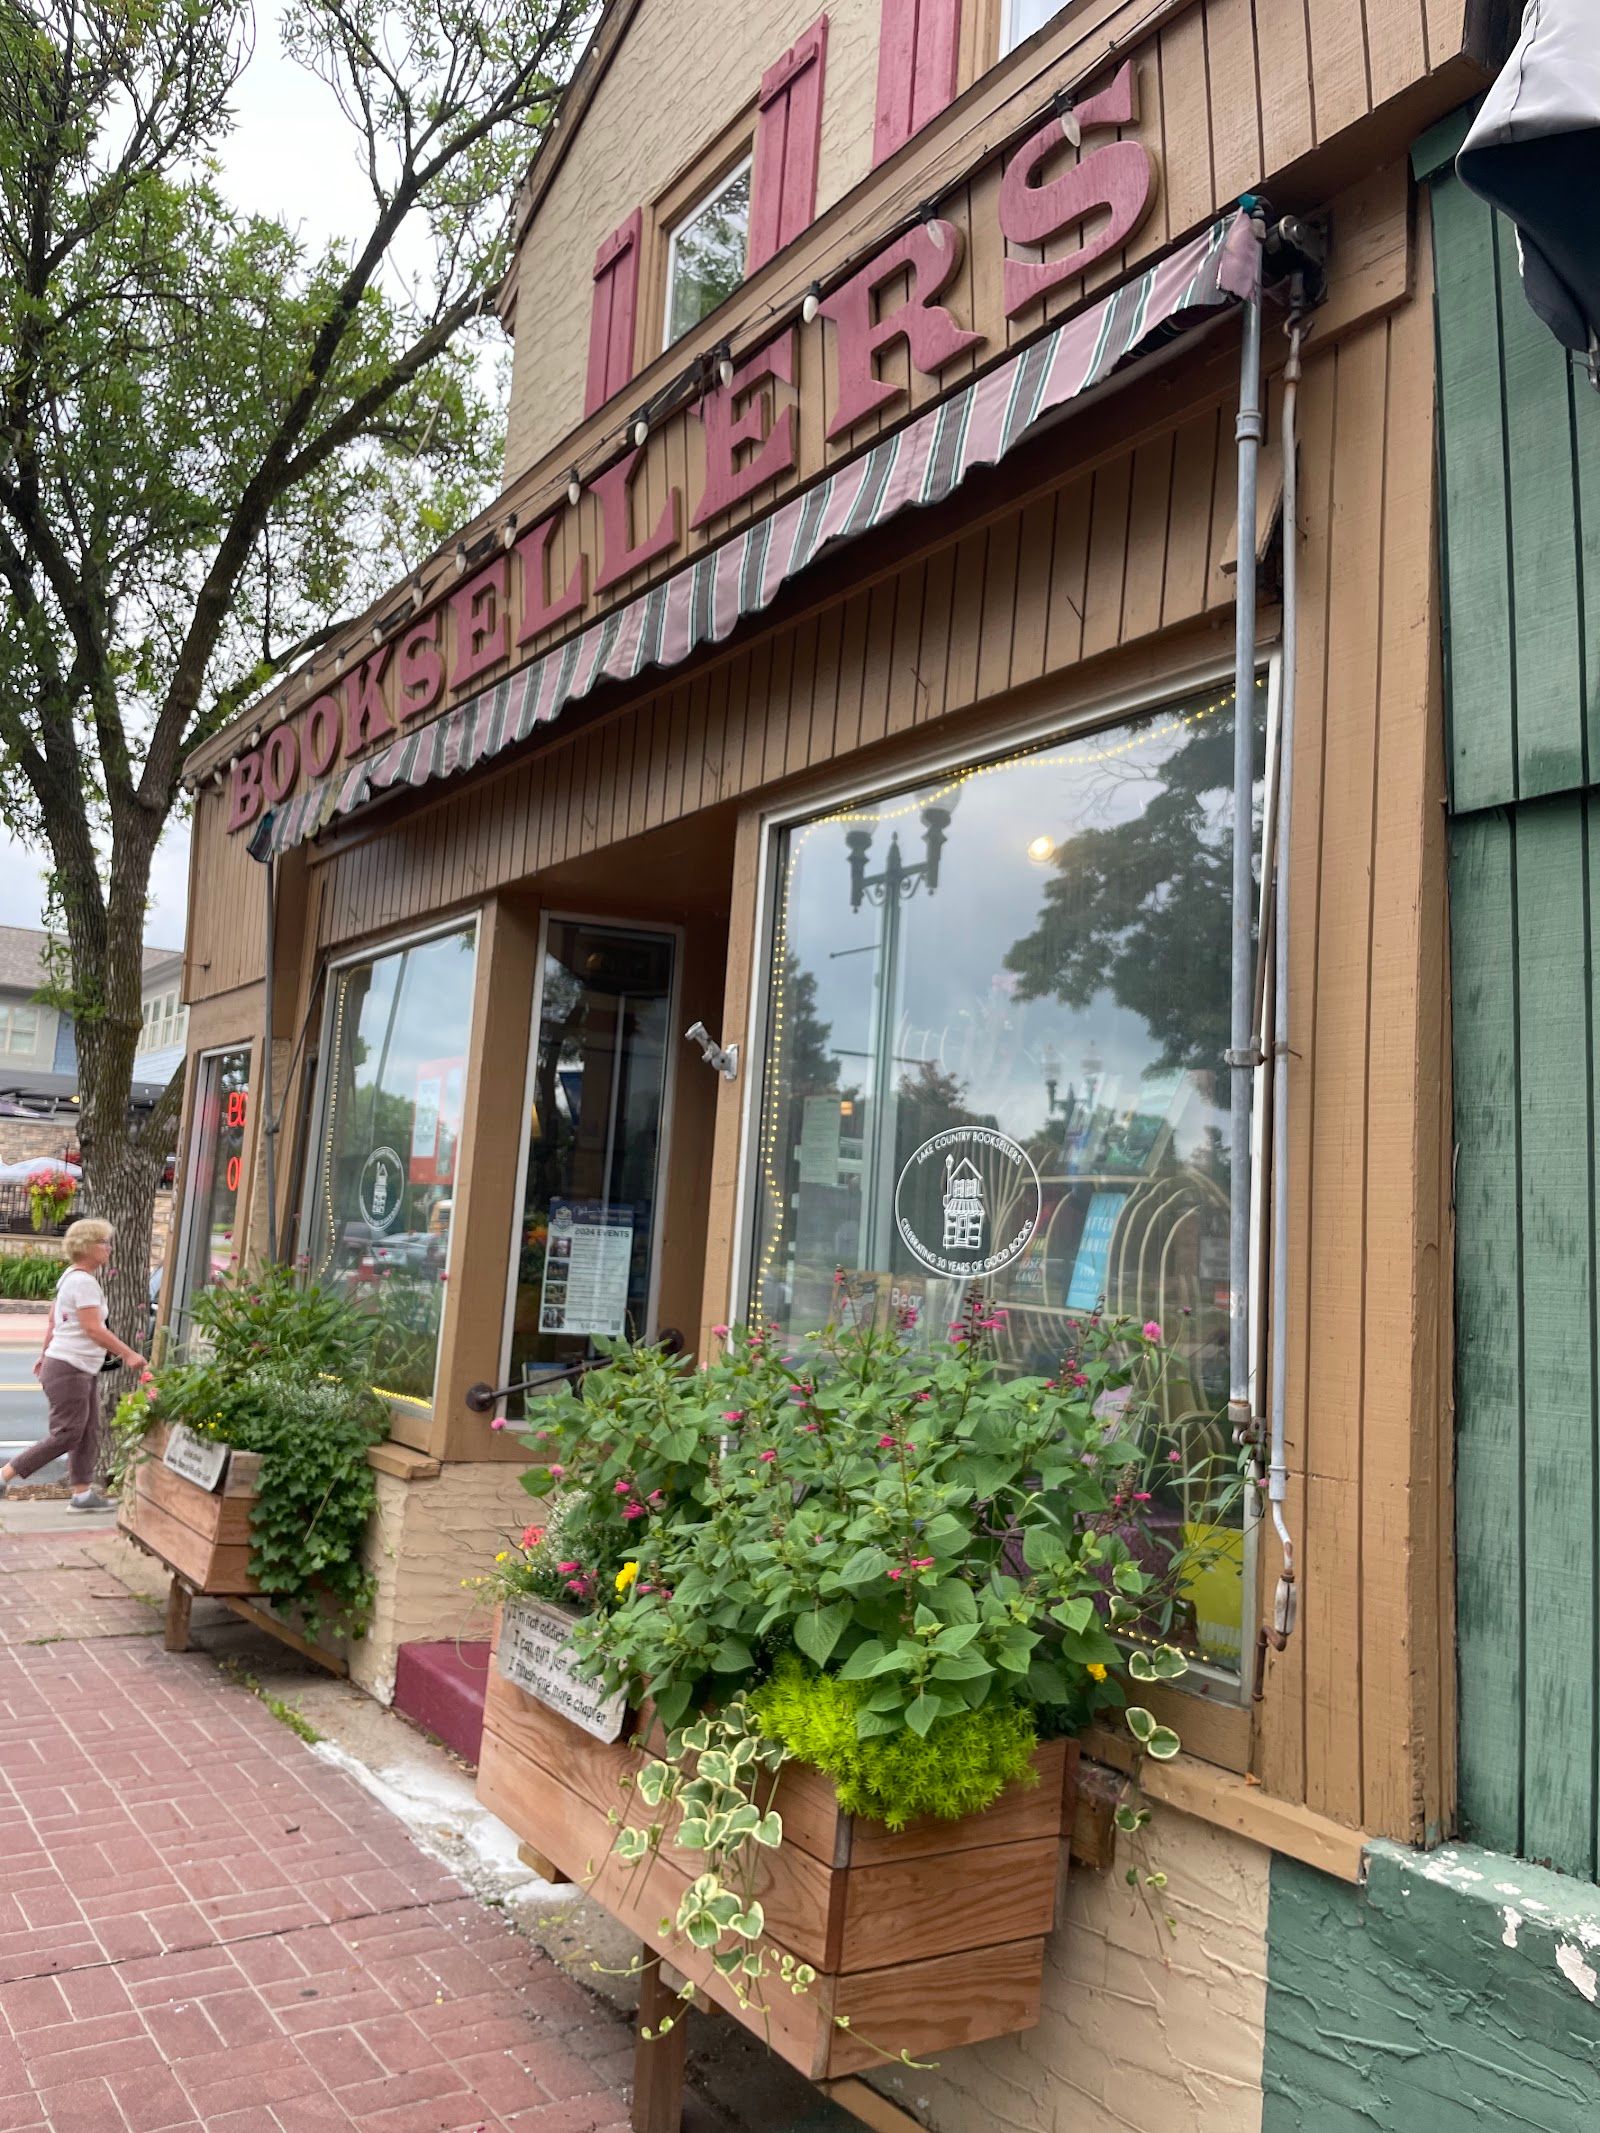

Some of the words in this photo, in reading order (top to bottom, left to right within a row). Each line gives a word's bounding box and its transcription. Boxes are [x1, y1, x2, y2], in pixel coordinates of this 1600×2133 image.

[227, 58, 1157, 834] BOOKSELLERS
[916, 1144, 935, 1165] LAKE
[934, 1131, 972, 1150] COUNTRY
[972, 1131, 1024, 1167] BOOKSELLERS
[574, 1227, 595, 1236] 2024
[900, 1217, 937, 1264] CELEBRATING
[935, 1256, 947, 1269] 30
[947, 1260, 971, 1272] YEARS
[971, 1259, 984, 1271] OF
[983, 1248, 1010, 1269] GOOD
[1008, 1218, 1034, 1252] BOOKS
[891, 1287, 922, 1307] Bear
[512, 1629, 520, 1648] I
[508, 1656, 516, 1671] I
[536, 1676, 551, 1696] one
[551, 1684, 573, 1706] more
